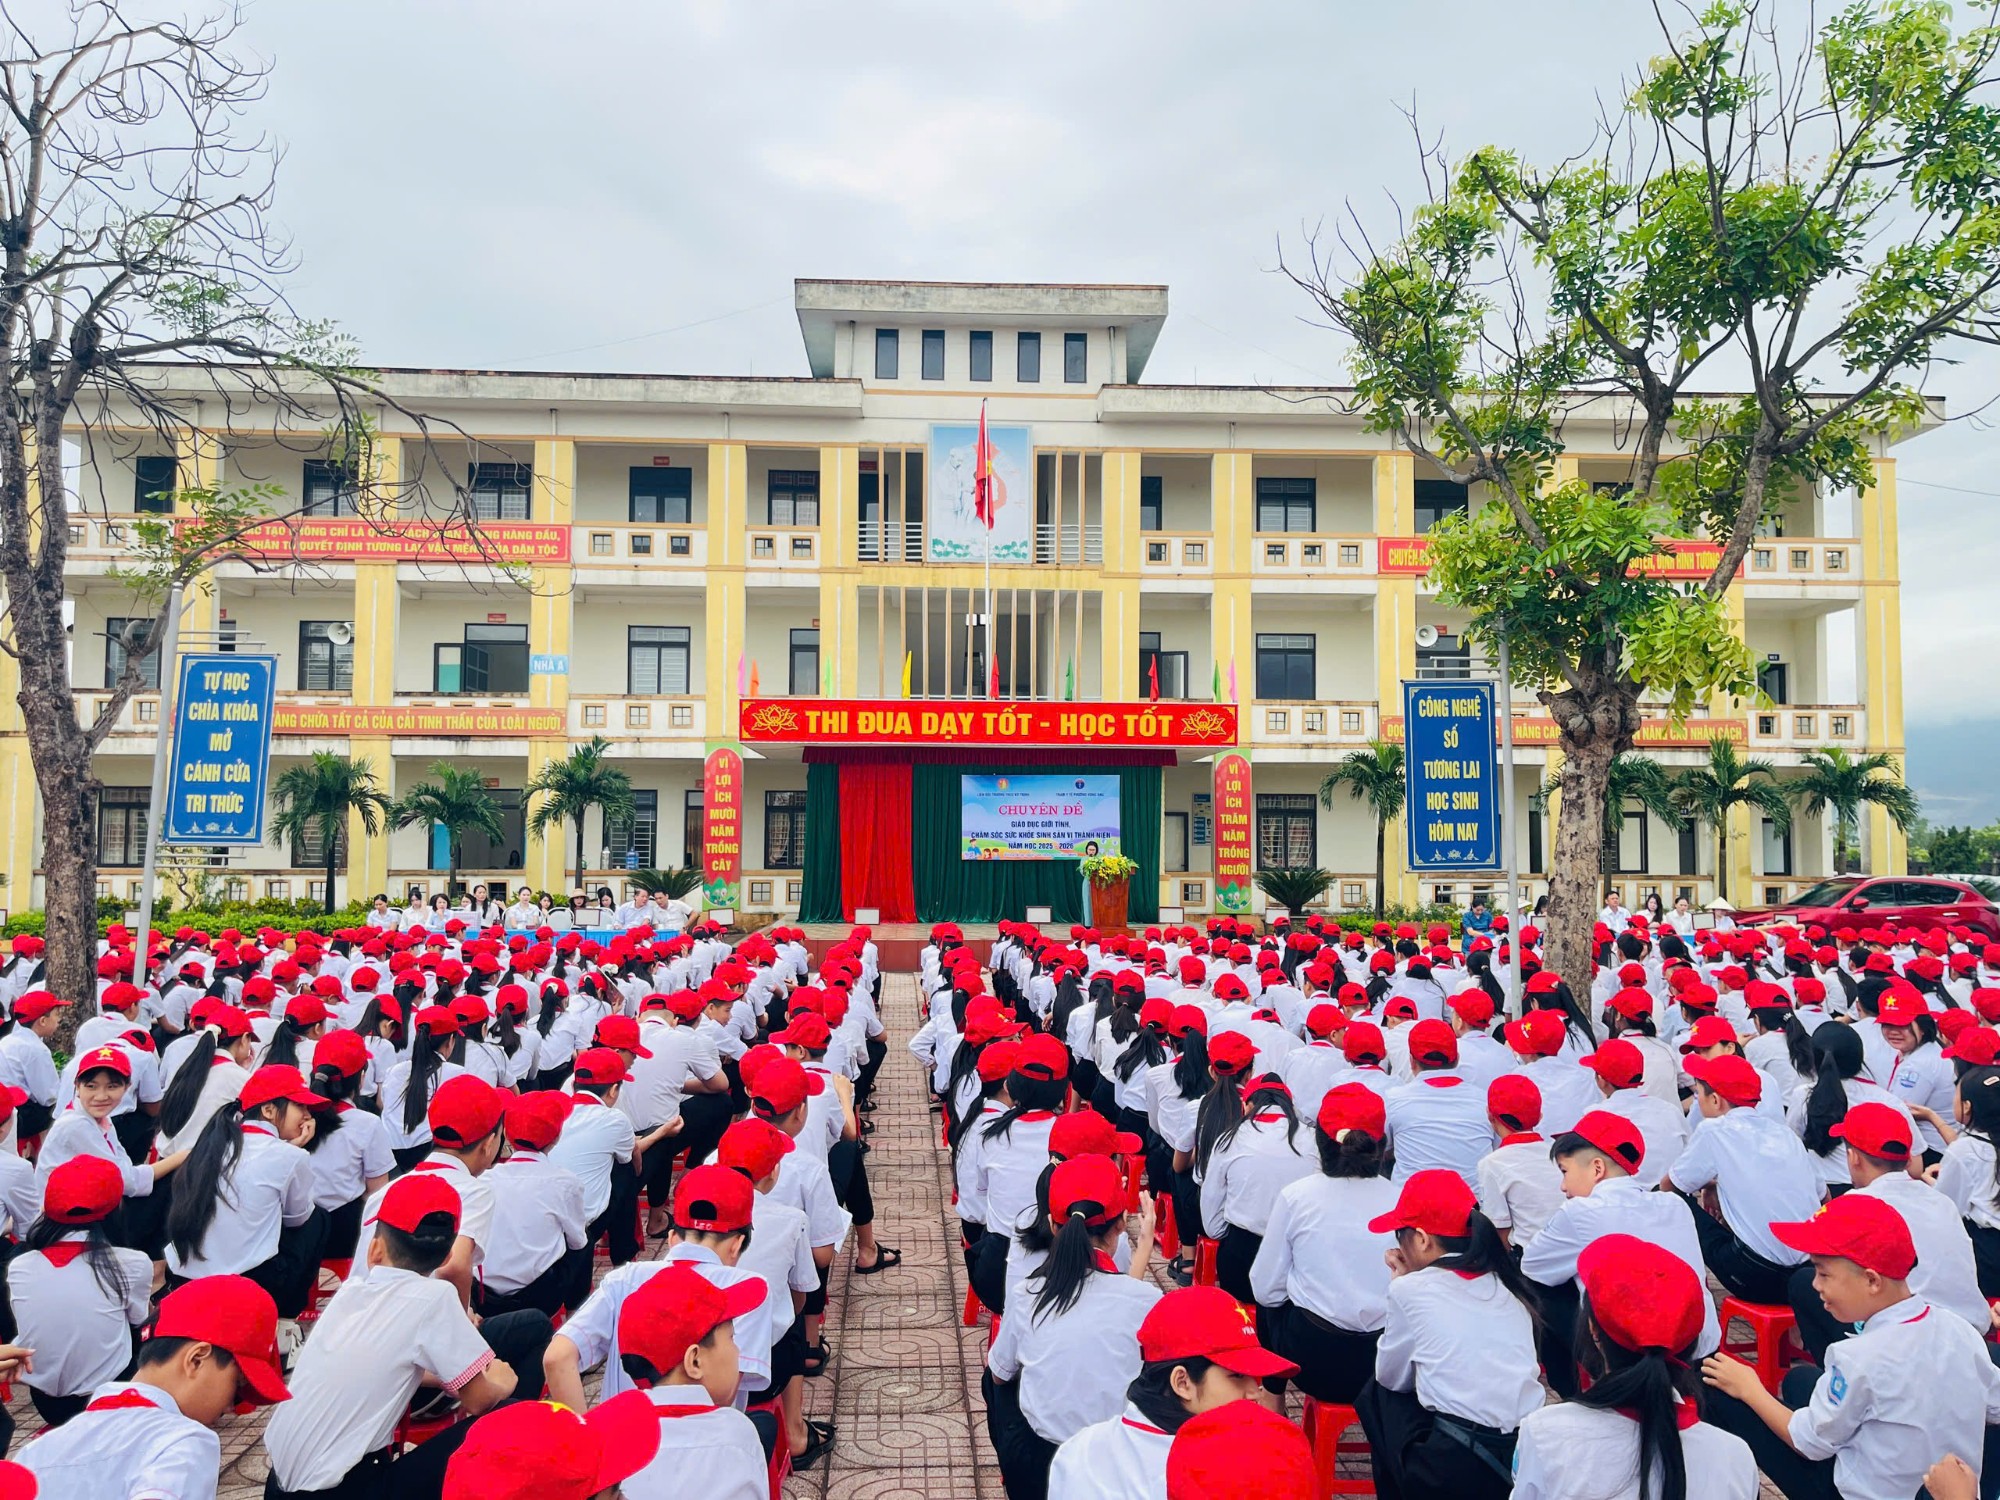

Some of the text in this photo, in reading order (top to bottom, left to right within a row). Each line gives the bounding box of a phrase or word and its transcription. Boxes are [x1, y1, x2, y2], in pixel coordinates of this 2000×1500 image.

[265, 526, 287, 538] TẠO
[330, 524, 348, 537] CHỈ
[351, 525, 365, 537] LÀ
[503, 528, 532, 540] HÀNG
[535, 528, 561, 541] ĐẦU,
[335, 541, 362, 553] ĐỊNH
[366, 541, 402, 552] TƯƠNG
[427, 542, 450, 554] VẬN
[512, 543, 534, 554] DÂN
[537, 544, 558, 556] TỘC
[1676, 548, 1694, 569] HÌNH
[533, 656, 564, 671] NHÀ A
[203, 671, 250, 694] TỰ HỌC
[188, 699, 258, 721] CHÌA KHÓA
[1418, 695, 1481, 720] CÔNG NGHỆ
[272, 709, 561, 731] ÀNG CHỨA TẤT CẢ CỦA CẢI TINH THẦN CỦA LOÀI NGƯỜI
[806, 710, 849, 734] THI
[857, 711, 912, 734] ĐUA
[922, 711, 970, 740] DẠY
[982, 706, 1032, 736] TỐT
[1060, 714, 1116, 740] HỌC
[1125, 706, 1173, 737] TỐT
[1443, 723, 1459, 748] SỐ
[1515, 722, 1541, 738] NÂNG
[1690, 726, 1716, 740] NHÂN
[1717, 724, 1742, 741] CÁCH
[209, 727, 233, 751] MỞ
[184, 758, 250, 782] CÁNH CỬA
[718, 756, 729, 769] VÌ
[1228, 762, 1239, 775] VÌ
[1423, 759, 1480, 779] TƯƠNG LAI
[715, 774, 732, 788] LỢI
[1226, 780, 1241, 794] LỢI
[186, 791, 244, 813] TRI THỨC
[714, 790, 732, 803] ÍCH
[1225, 796, 1242, 808] ÍCH
[1426, 791, 1479, 814] HỌC SINH
[709, 806, 736, 820] MƯỜI
[998, 800, 1083, 815] CHUYÊN ĐỀ
[1220, 813, 1248, 825] TRĂM
[710, 824, 735, 837] NĂM
[991, 830, 1003, 839] SÓC
[1005, 830, 1017, 839] SỨC
[1036, 831, 1051, 839] SINH
[1074, 830, 1095, 839] THÀNH
[1222, 829, 1246, 842] NĂM
[1428, 819, 1479, 841] HÔM NAY
[706, 840, 739, 854] TRỒNG
[1008, 842, 1023, 850] NĂM
[1024, 842, 1037, 850] HỌC
[1038, 842, 1054, 850] 2025
[1059, 842, 1074, 850] 2026
[1218, 845, 1250, 859] TRỒNG
[711, 858, 732, 871] CÂY
[1219, 862, 1249, 875] NGƯỜI
